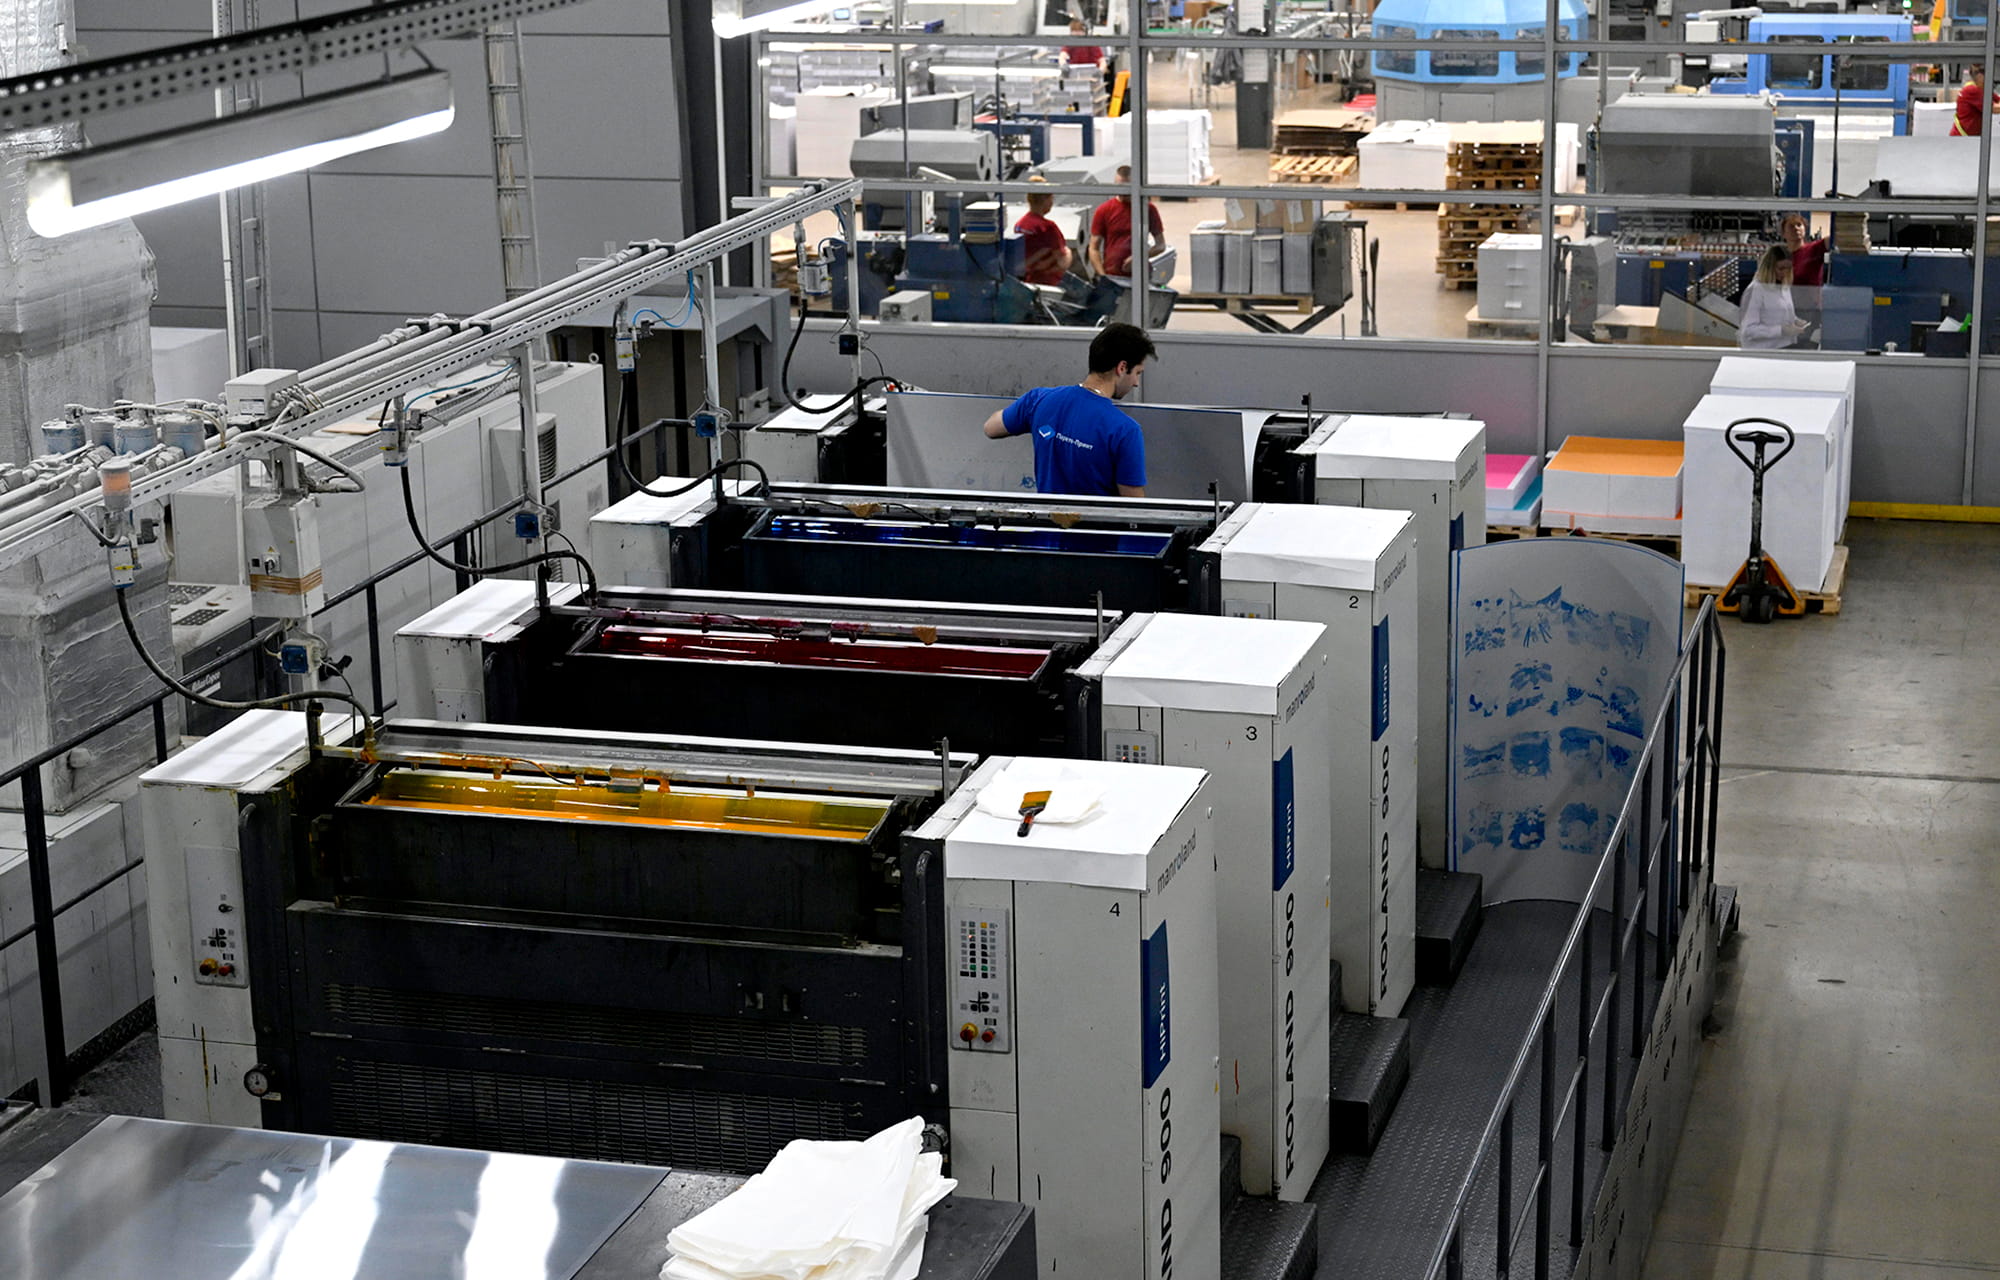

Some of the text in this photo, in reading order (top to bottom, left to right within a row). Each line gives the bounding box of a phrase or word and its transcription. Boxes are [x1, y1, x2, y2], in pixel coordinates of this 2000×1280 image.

[1431, 492, 1437, 505] 1
[1383, 552, 1407, 594] manroland
[1349, 595, 1359, 609] 2
[1286, 671, 1315, 724] manroland
[1246, 725, 1258, 741] 3
[1157, 827, 1196, 896] manroland
[1109, 902, 1120, 917] 4
[1380, 831, 1389, 1000] ROLAND
[1286, 892, 1294, 1180] ROLAND 900
[1160, 1087, 1172, 1184] 900
